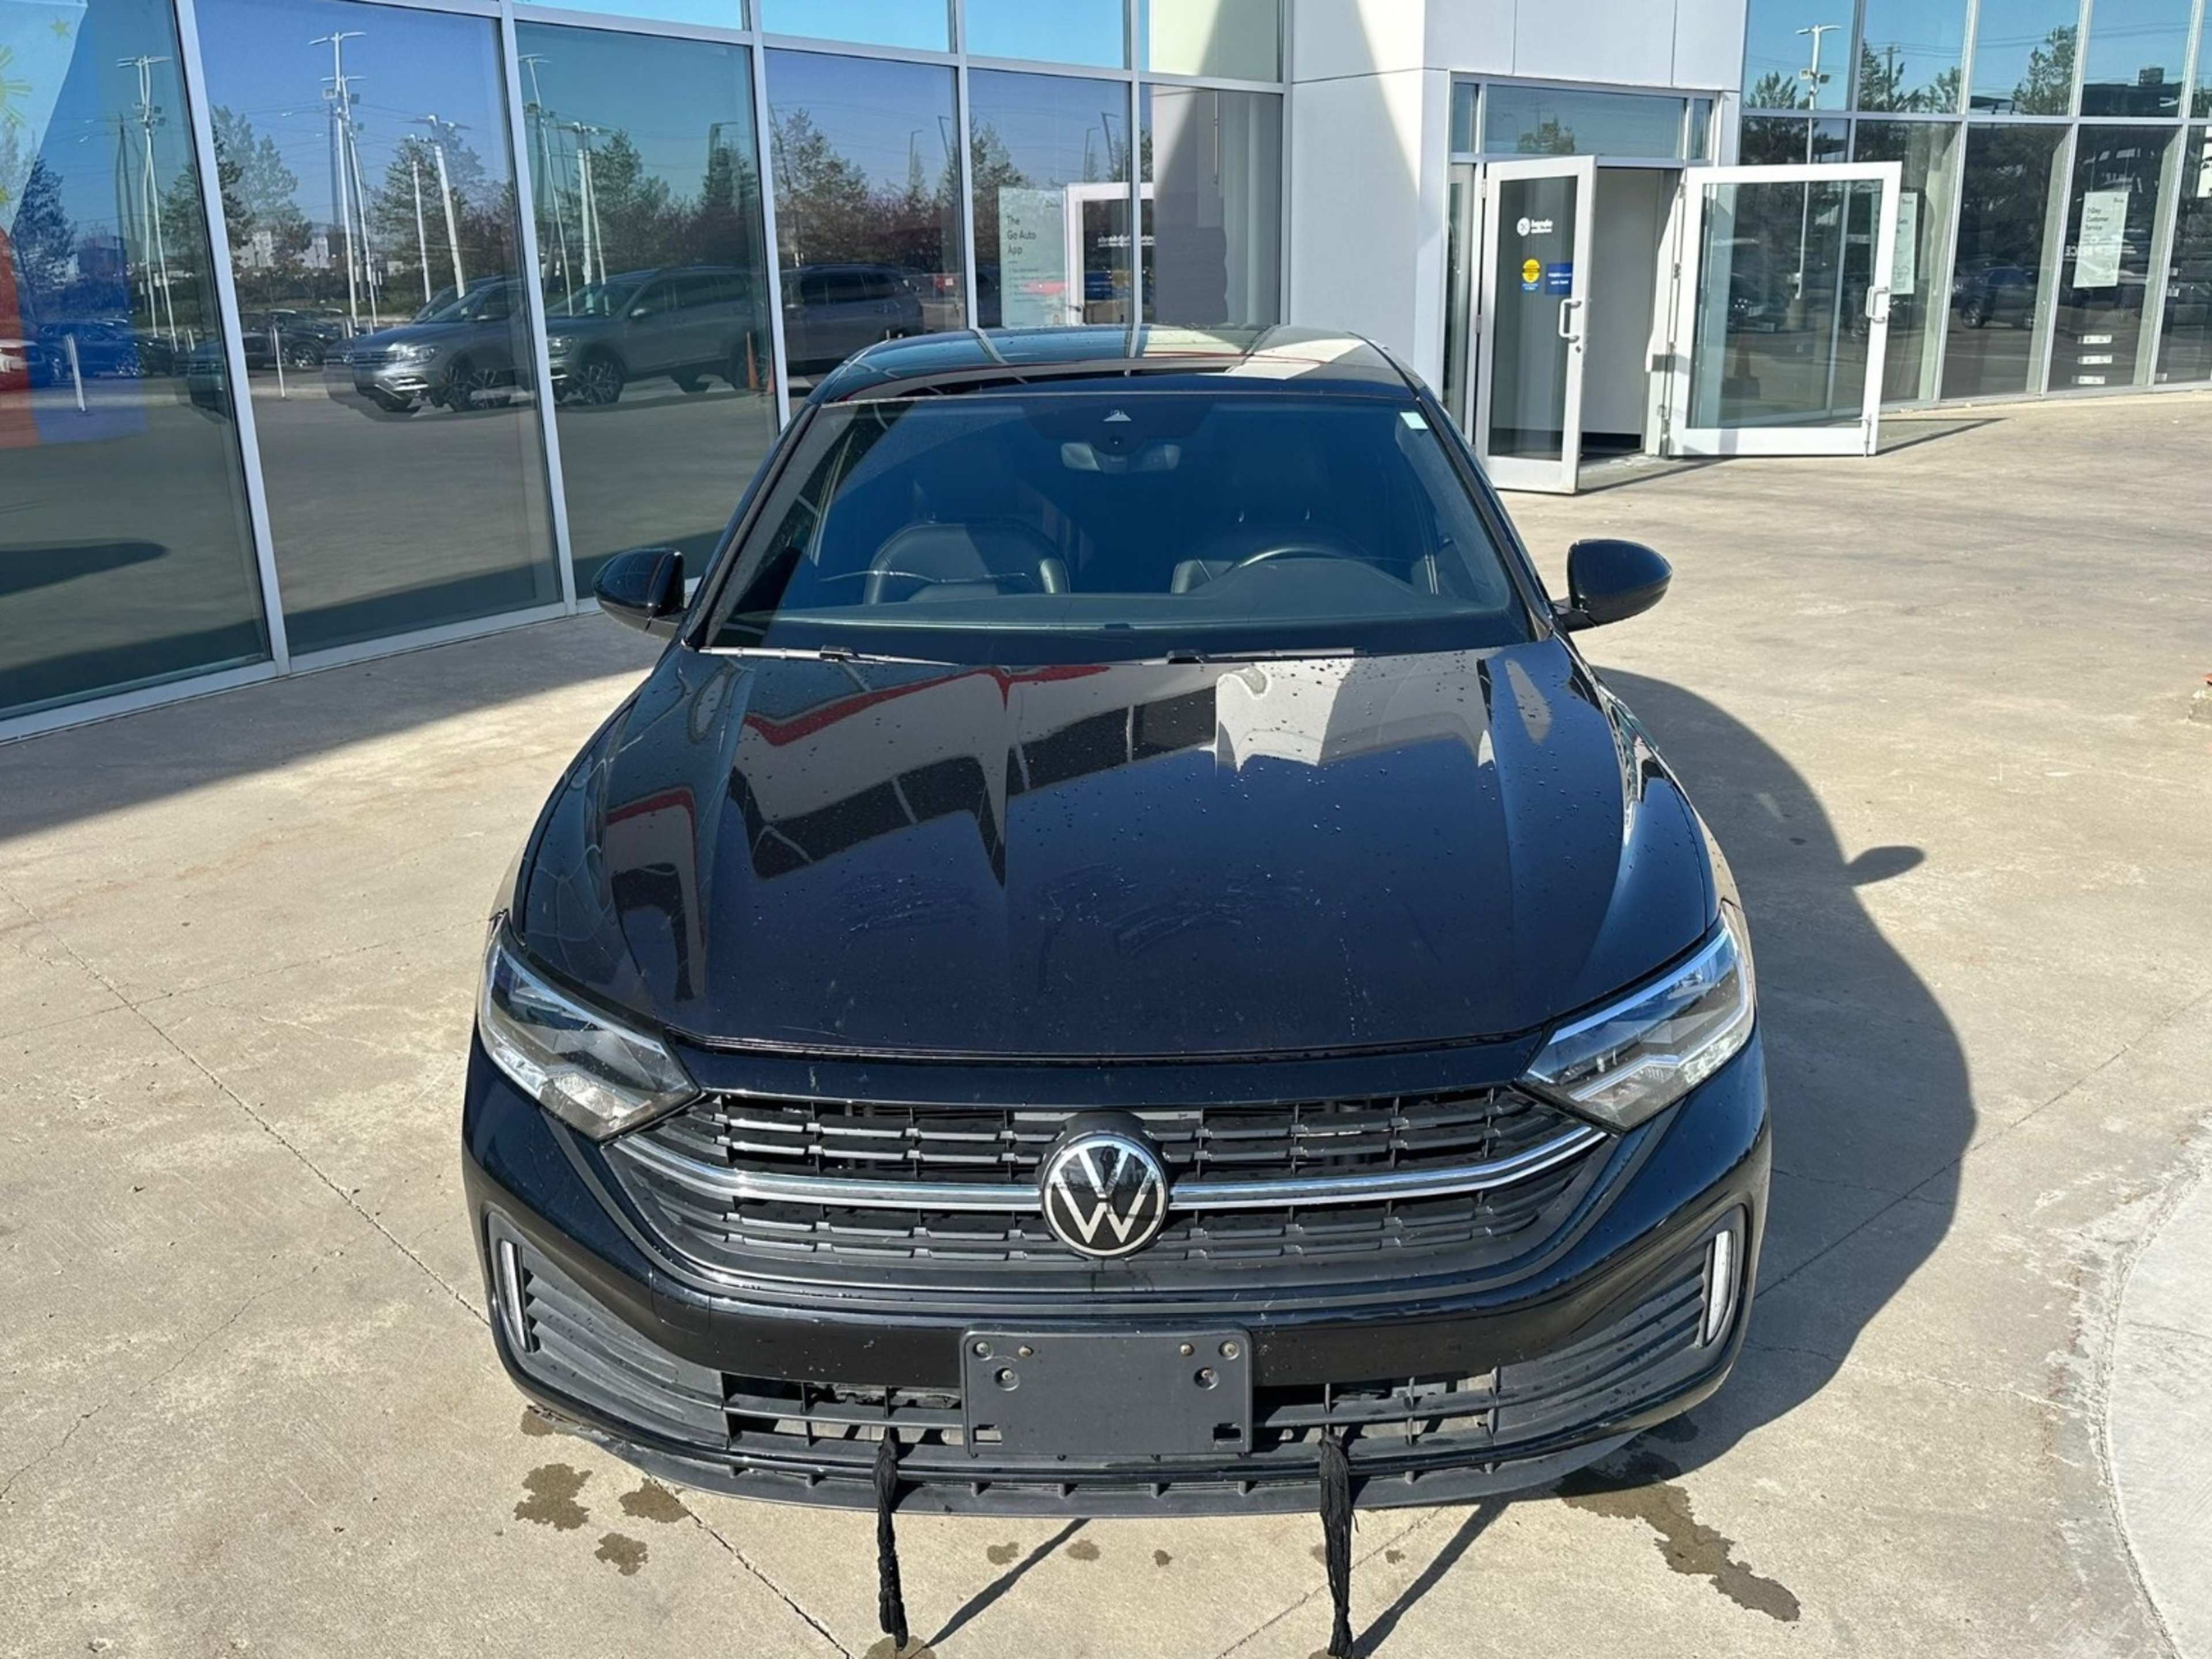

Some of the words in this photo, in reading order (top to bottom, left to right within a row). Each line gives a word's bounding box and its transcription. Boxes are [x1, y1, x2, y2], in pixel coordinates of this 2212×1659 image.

[1007, 215, 1020, 226] The
[1006, 230, 1018, 240] Go
[1019, 230, 1037, 240] Auto
[1007, 244, 1023, 255] App
